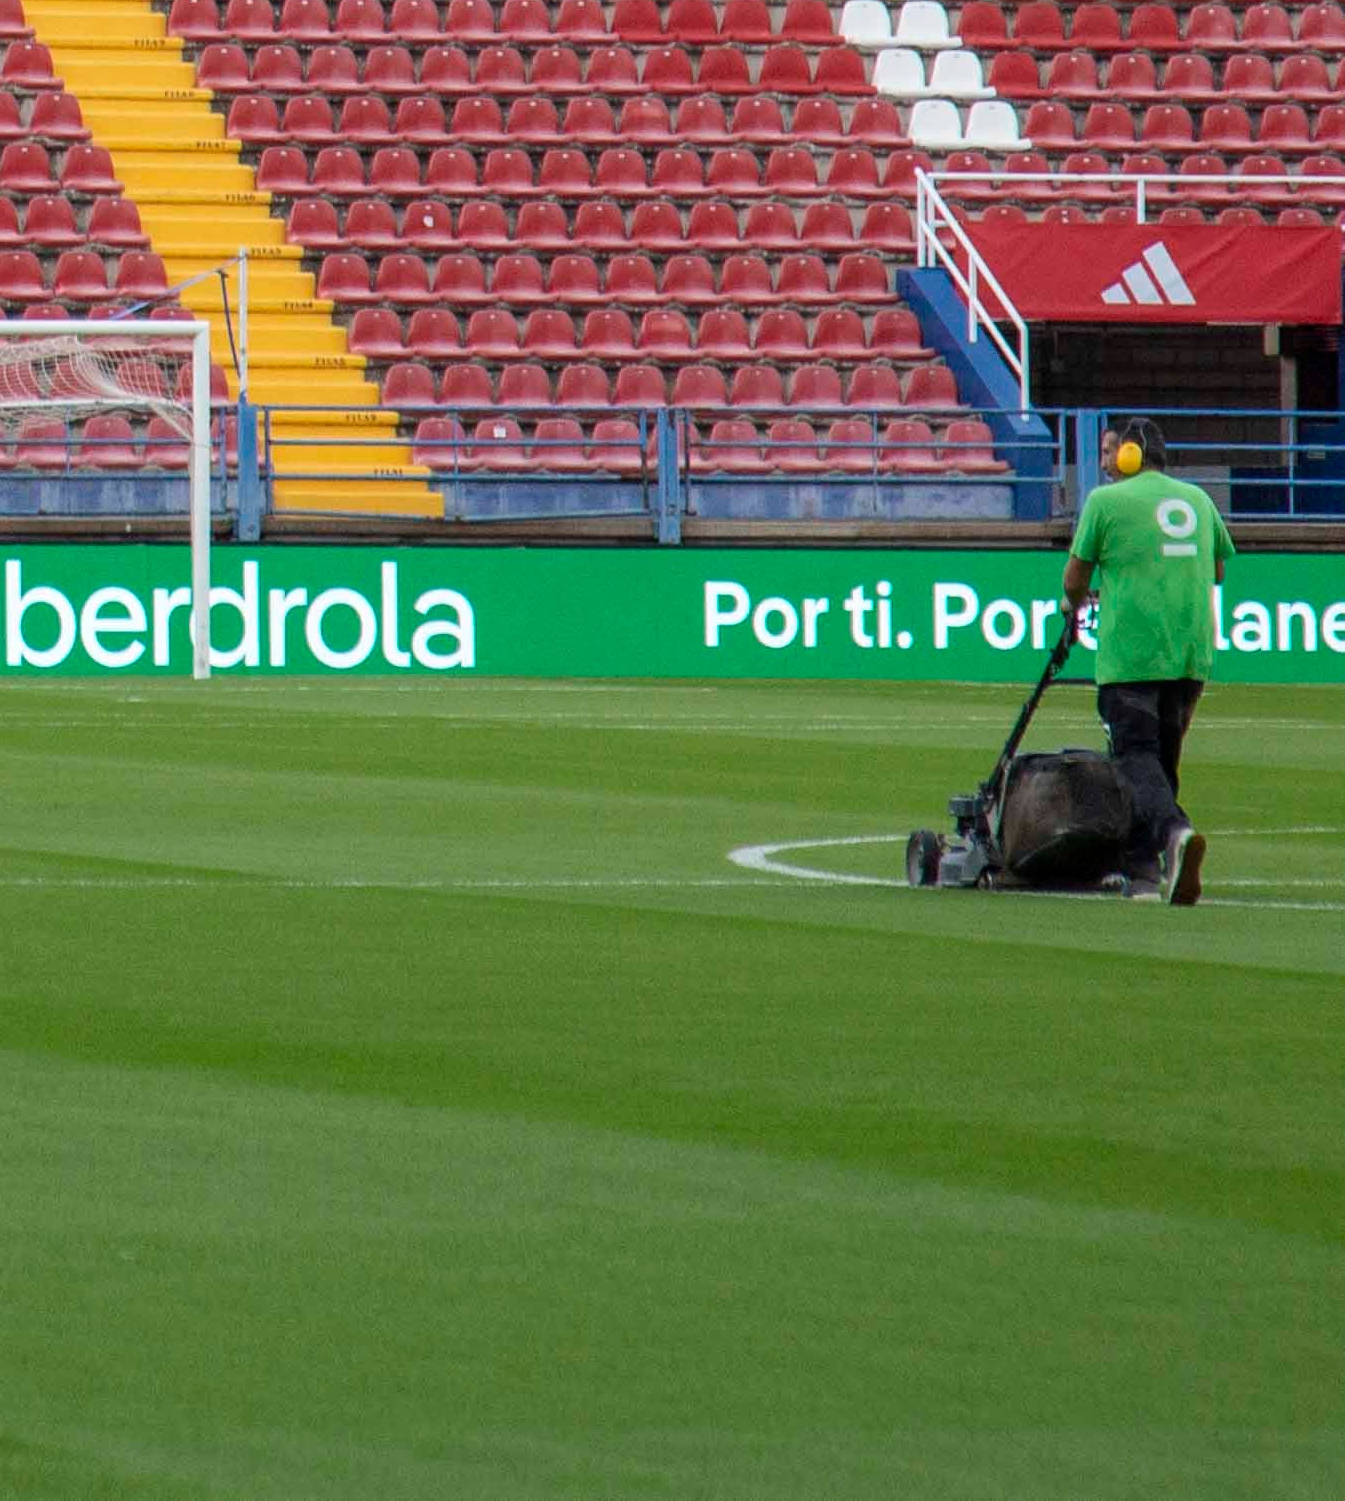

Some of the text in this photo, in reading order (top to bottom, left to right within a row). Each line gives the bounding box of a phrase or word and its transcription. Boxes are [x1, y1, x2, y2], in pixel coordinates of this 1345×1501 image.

[704, 580, 828, 648] Por
[843, 580, 913, 649] ti.
[933, 582, 1057, 650] Por
[1211, 584, 1345, 653] lane
